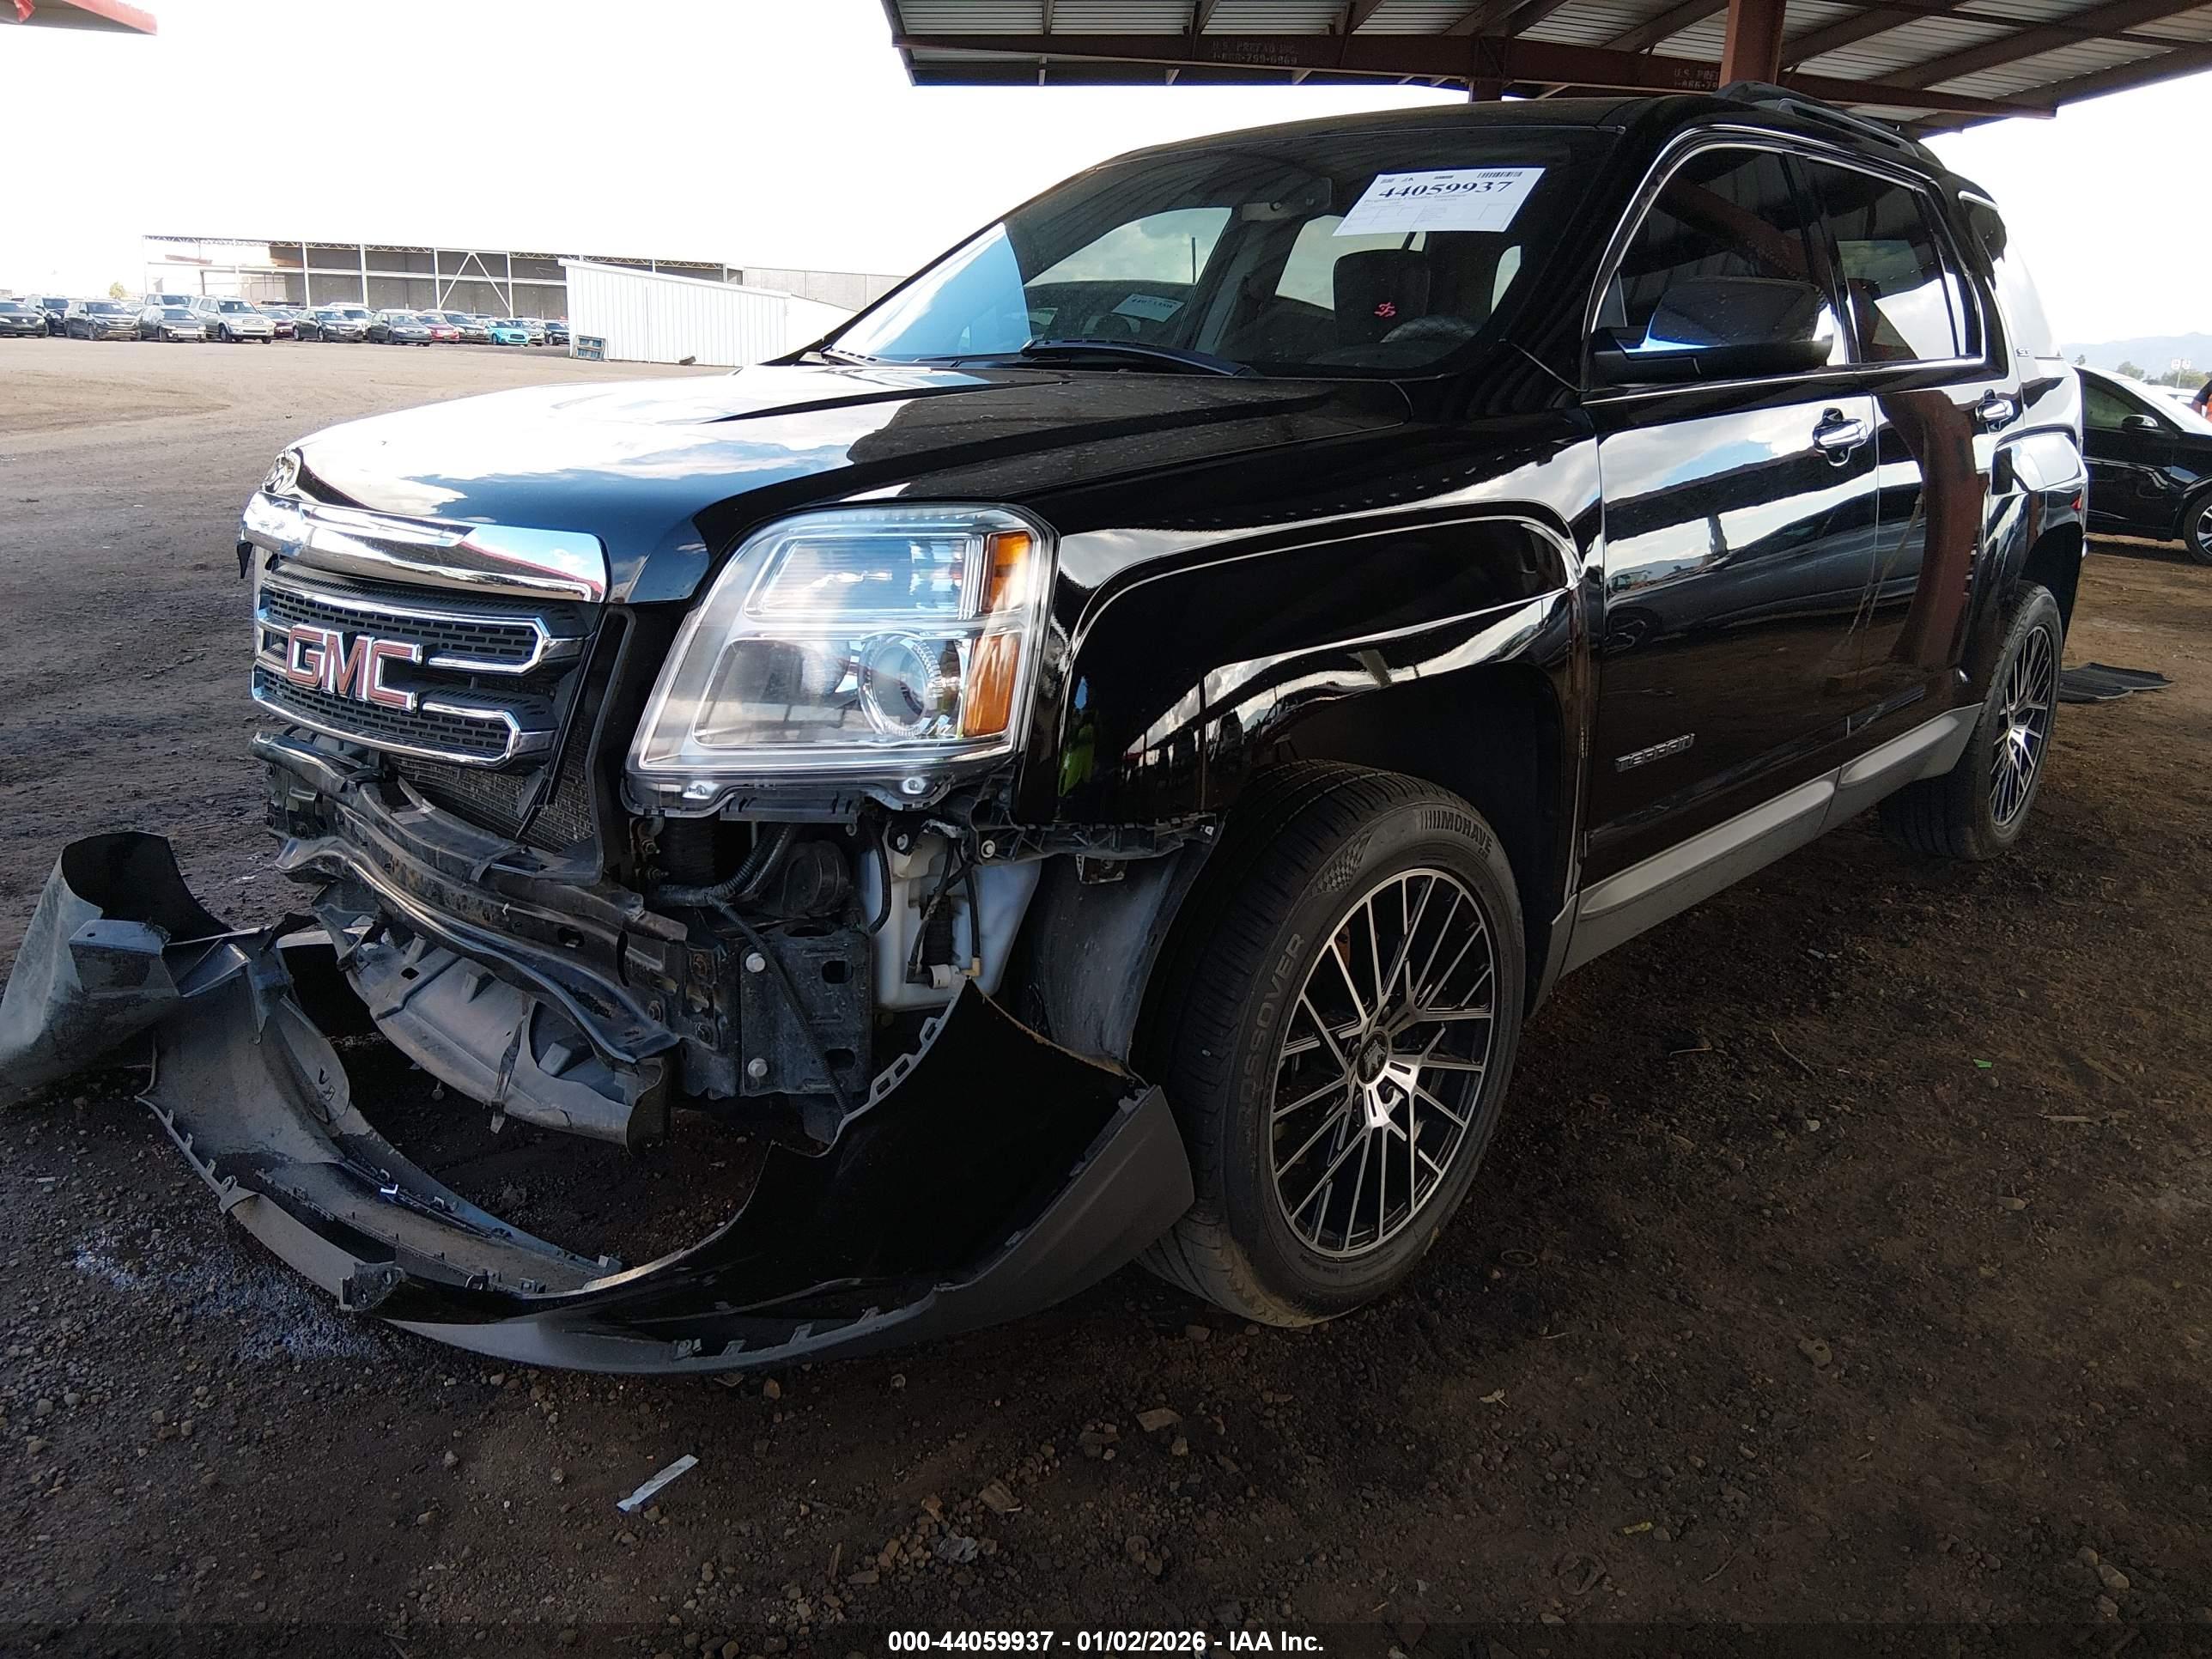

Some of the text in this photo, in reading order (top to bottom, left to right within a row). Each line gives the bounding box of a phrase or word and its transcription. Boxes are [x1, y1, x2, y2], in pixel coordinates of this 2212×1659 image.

[1378, 180, 1514, 198] 44059937
[287, 623, 422, 712] GMC
[1615, 733, 1695, 772] TERRAIN
